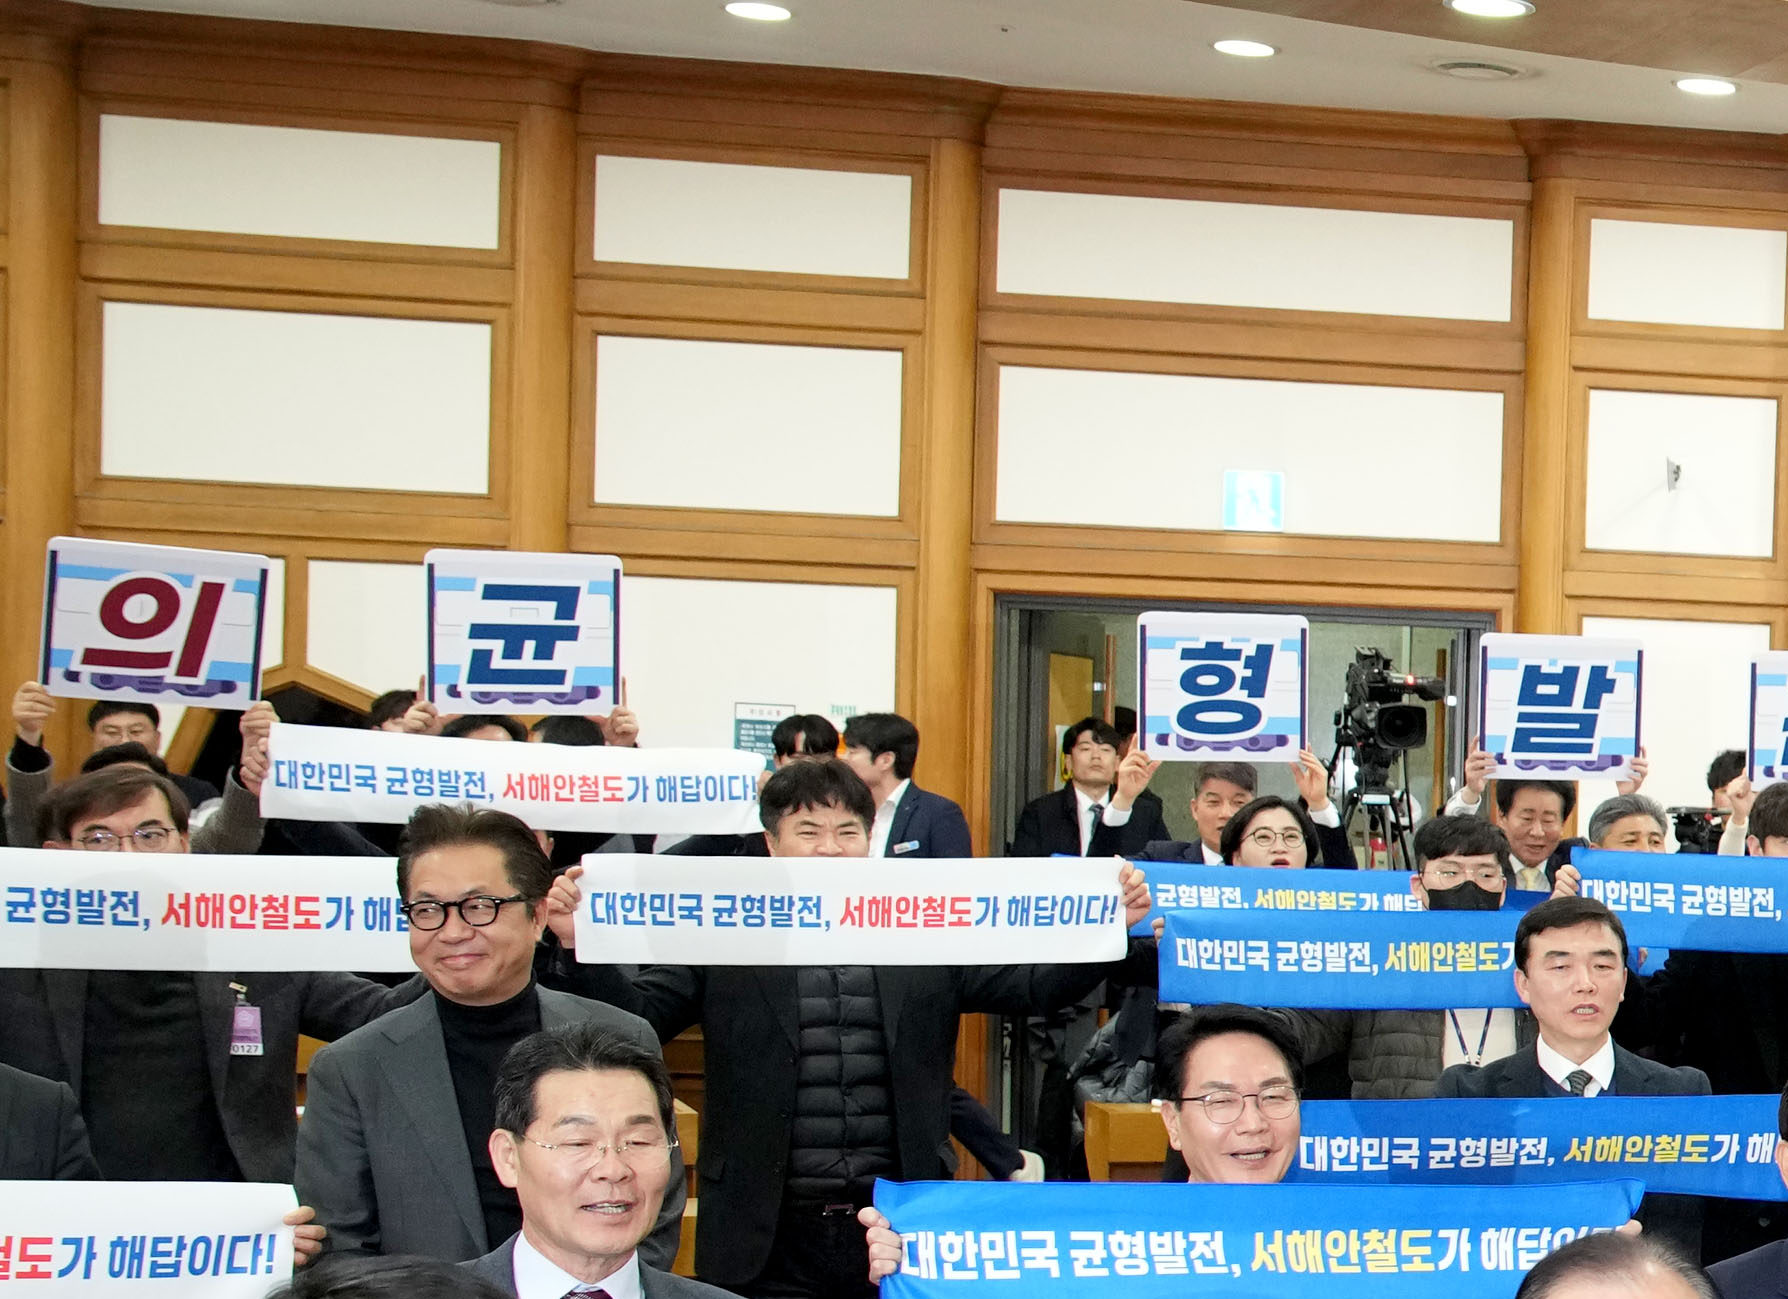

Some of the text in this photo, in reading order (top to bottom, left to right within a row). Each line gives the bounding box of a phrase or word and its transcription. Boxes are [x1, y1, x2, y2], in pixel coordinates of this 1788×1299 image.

[82, 577, 225, 680] 의
[467, 584, 581, 686] 균
[1178, 642, 1271, 735] 형
[1510, 665, 1614, 755] 발
[274, 756, 757, 806] 대한민국 균형발전, 서해안철도가 해답이다!
[6, 886, 150, 931] 균형발전,
[161, 893, 354, 931] 서해안철도가
[591, 893, 703, 928] 대한민국
[712, 893, 831, 930] 균형발전,
[840, 893, 1000, 929] 서해안철도가
[1007, 895, 1118, 928] 해답이다!
[1581, 878, 1675, 913] 대한민국
[1681, 883, 1783, 922] 균형발전,
[1176, 938, 1269, 971] 대한민국
[1276, 941, 1378, 976] 균형발전,
[1300, 1136, 1420, 1173] 대한민국
[1428, 1136, 1555, 1171] 균형발전,
[1562, 1133, 1739, 1165] 서해안철도가
[108, 1235, 275, 1279] 해답이다!
[900, 1229, 1470, 1282] 대한민국 균형발전, 서해안철도가
